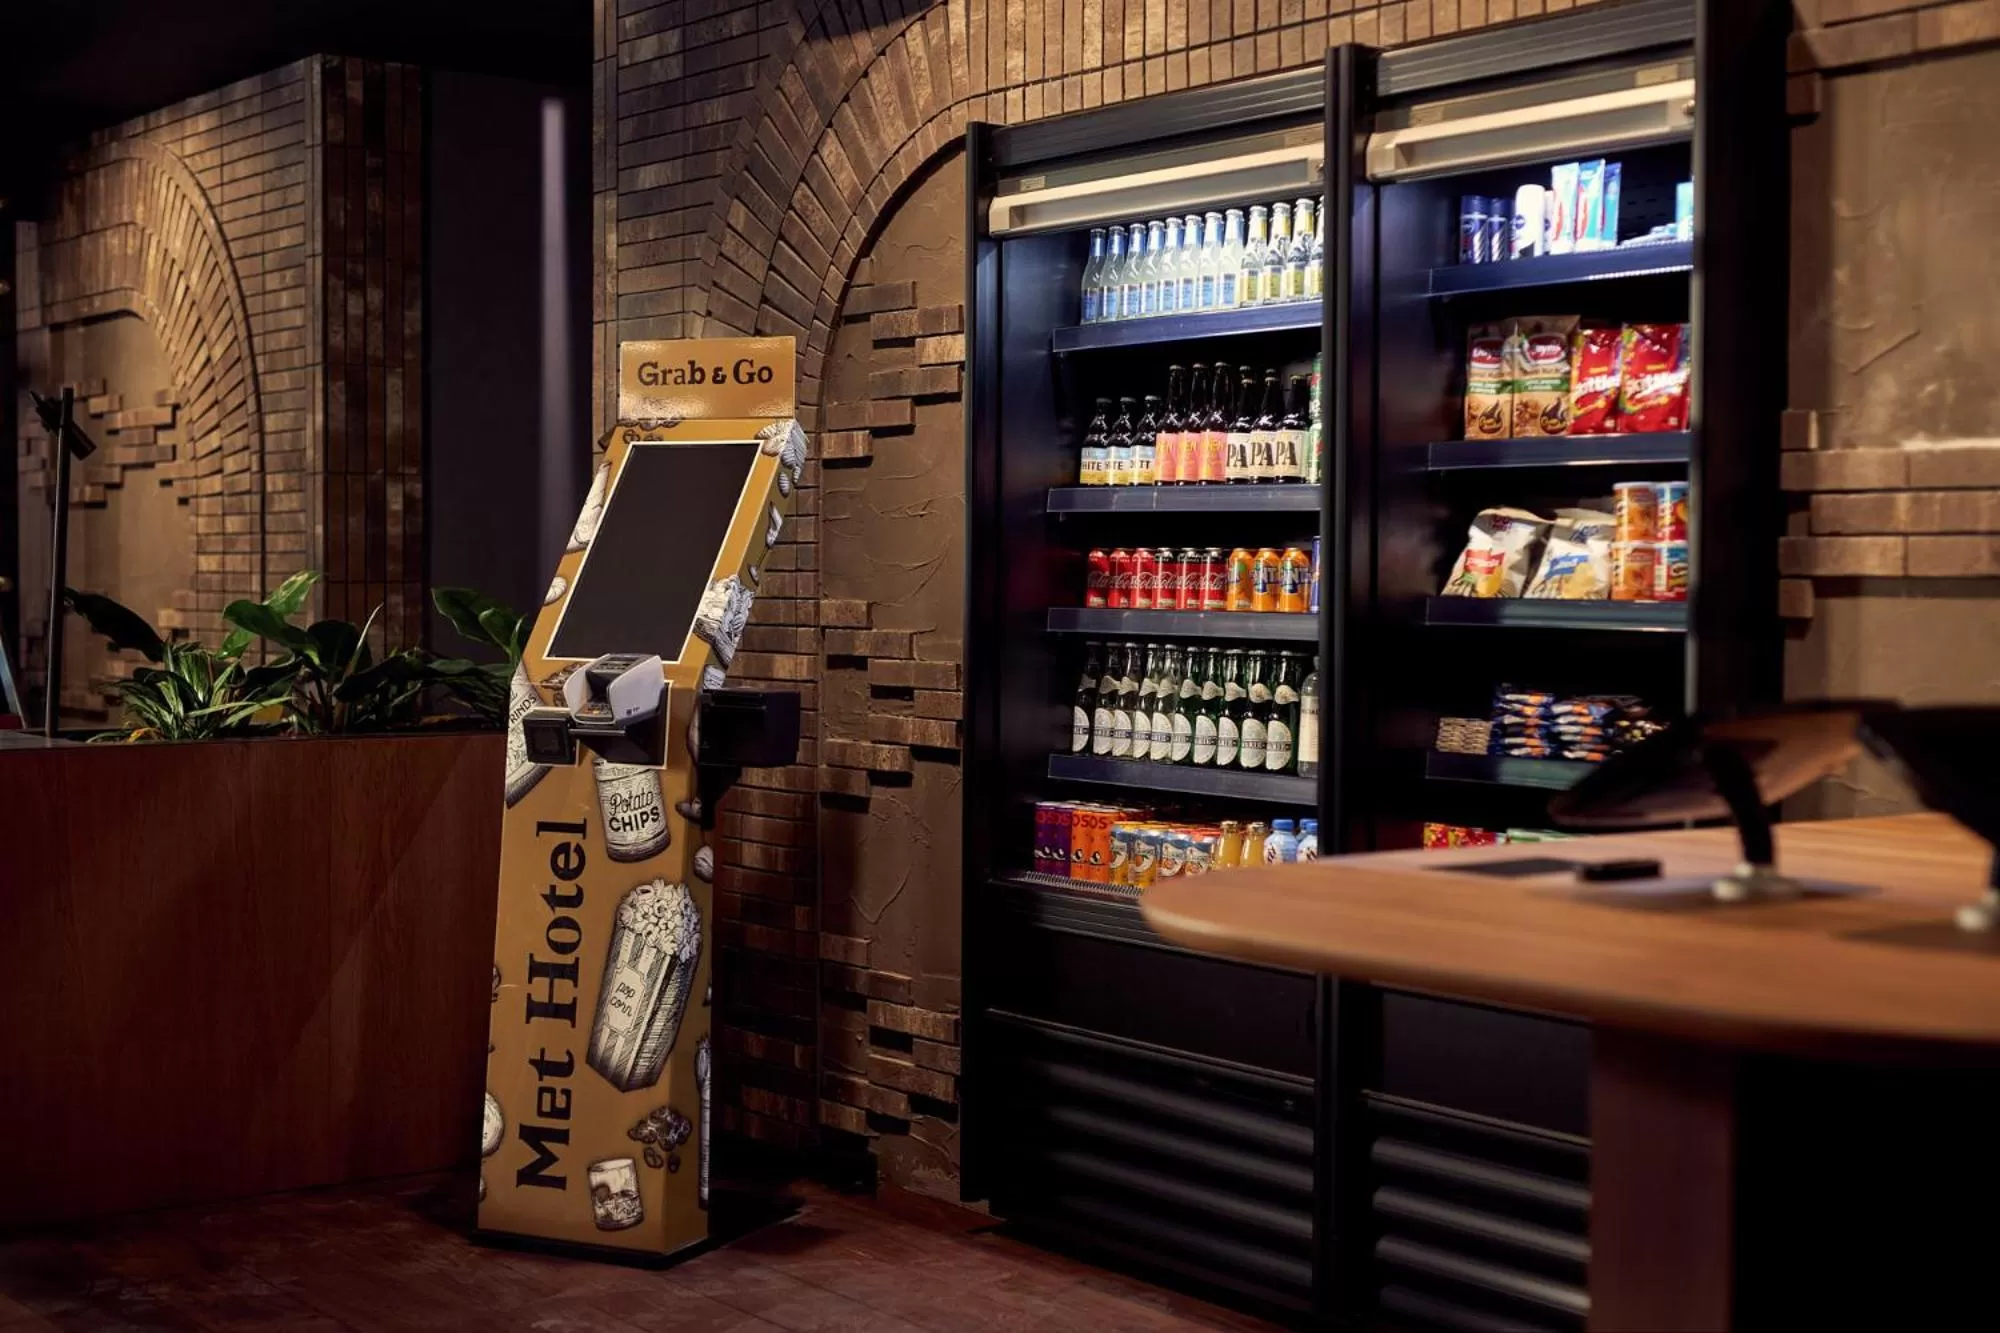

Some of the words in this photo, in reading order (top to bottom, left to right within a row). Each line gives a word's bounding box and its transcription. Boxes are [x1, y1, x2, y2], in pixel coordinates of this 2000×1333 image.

[637, 360, 706, 386] Grab
[712, 366, 727, 385] &
[733, 358, 773, 384] Go
[609, 787, 654, 816] Potato
[609, 806, 660, 832] CHIPS
[525, 817, 588, 1029] Hotel
[615, 982, 636, 999] pop
[611, 996, 633, 1017] corn
[516, 1047, 576, 1191] Met
